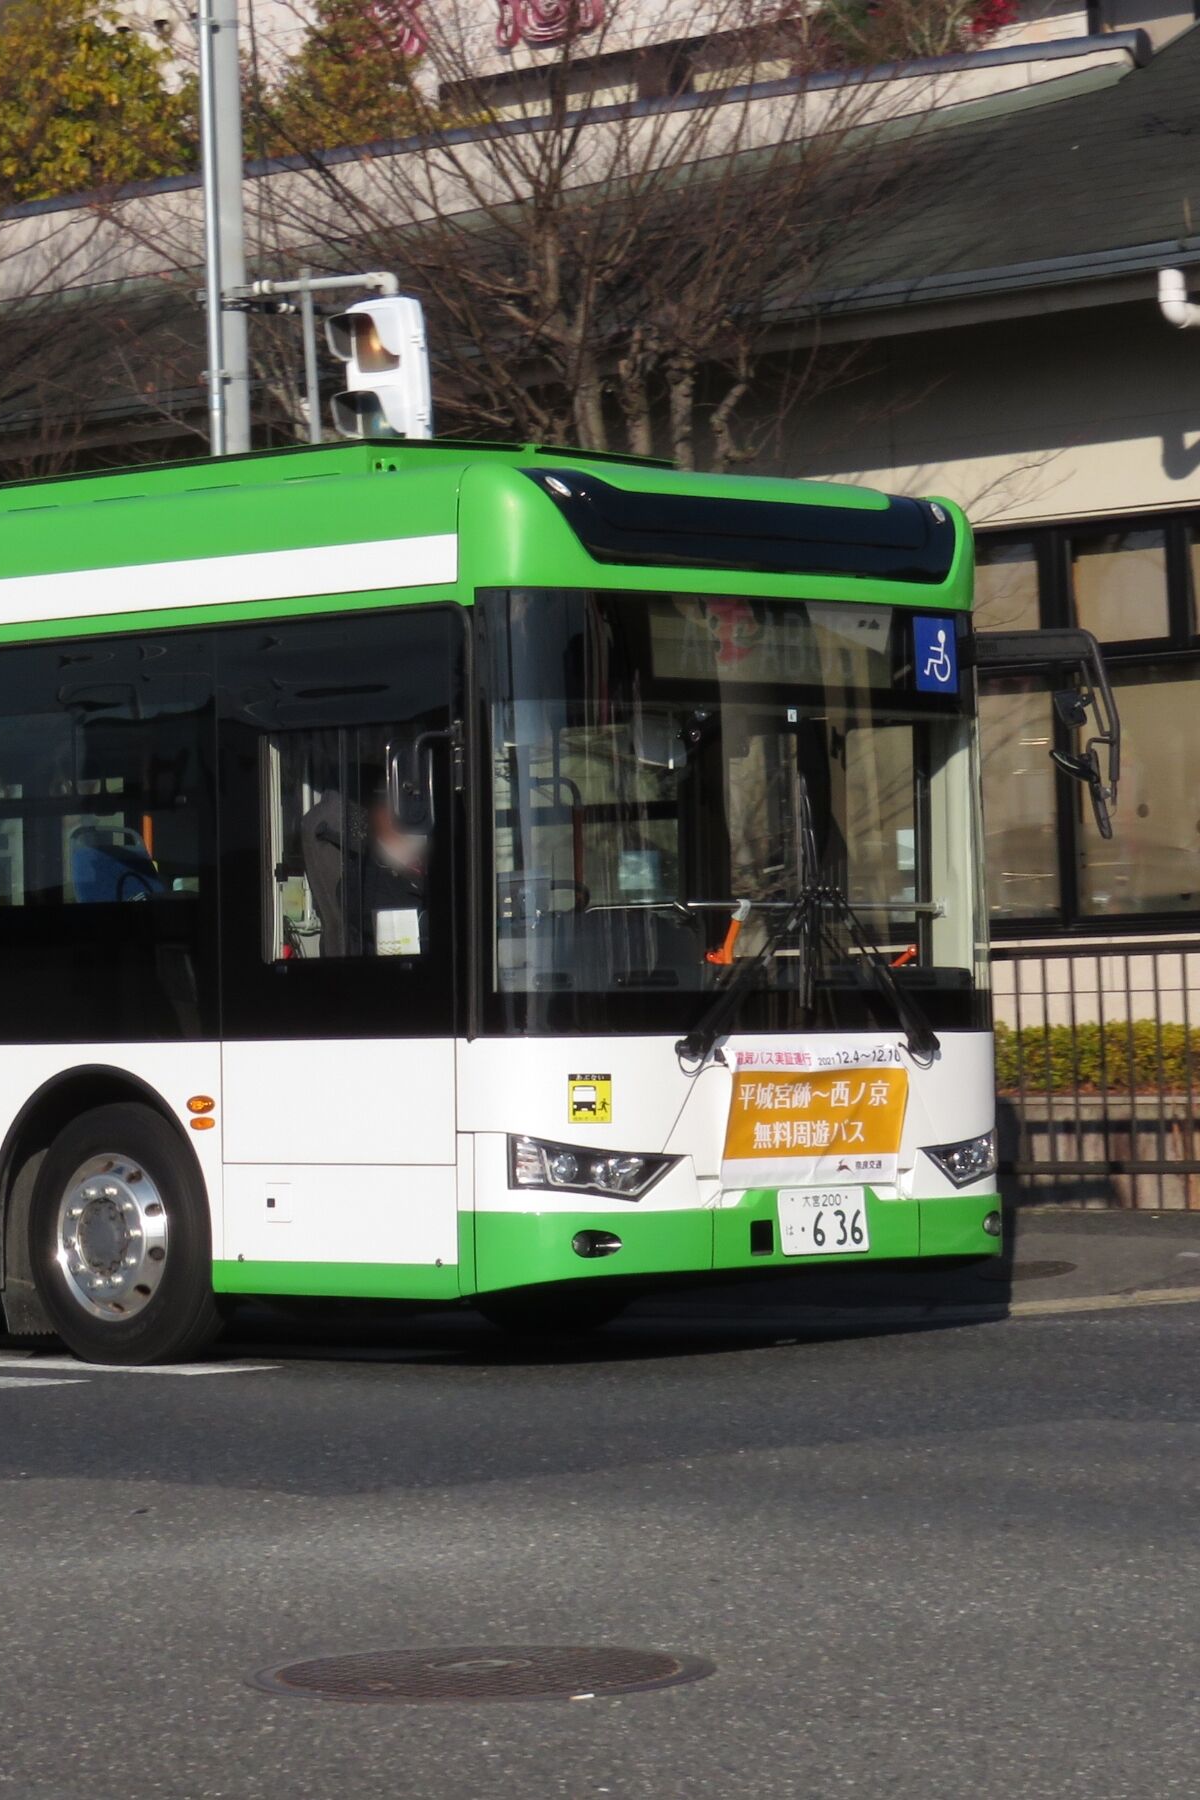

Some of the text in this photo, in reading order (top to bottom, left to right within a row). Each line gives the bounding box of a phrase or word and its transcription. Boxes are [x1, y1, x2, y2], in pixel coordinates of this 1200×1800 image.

[753, 1120, 865, 1149] 無料周遊バス
